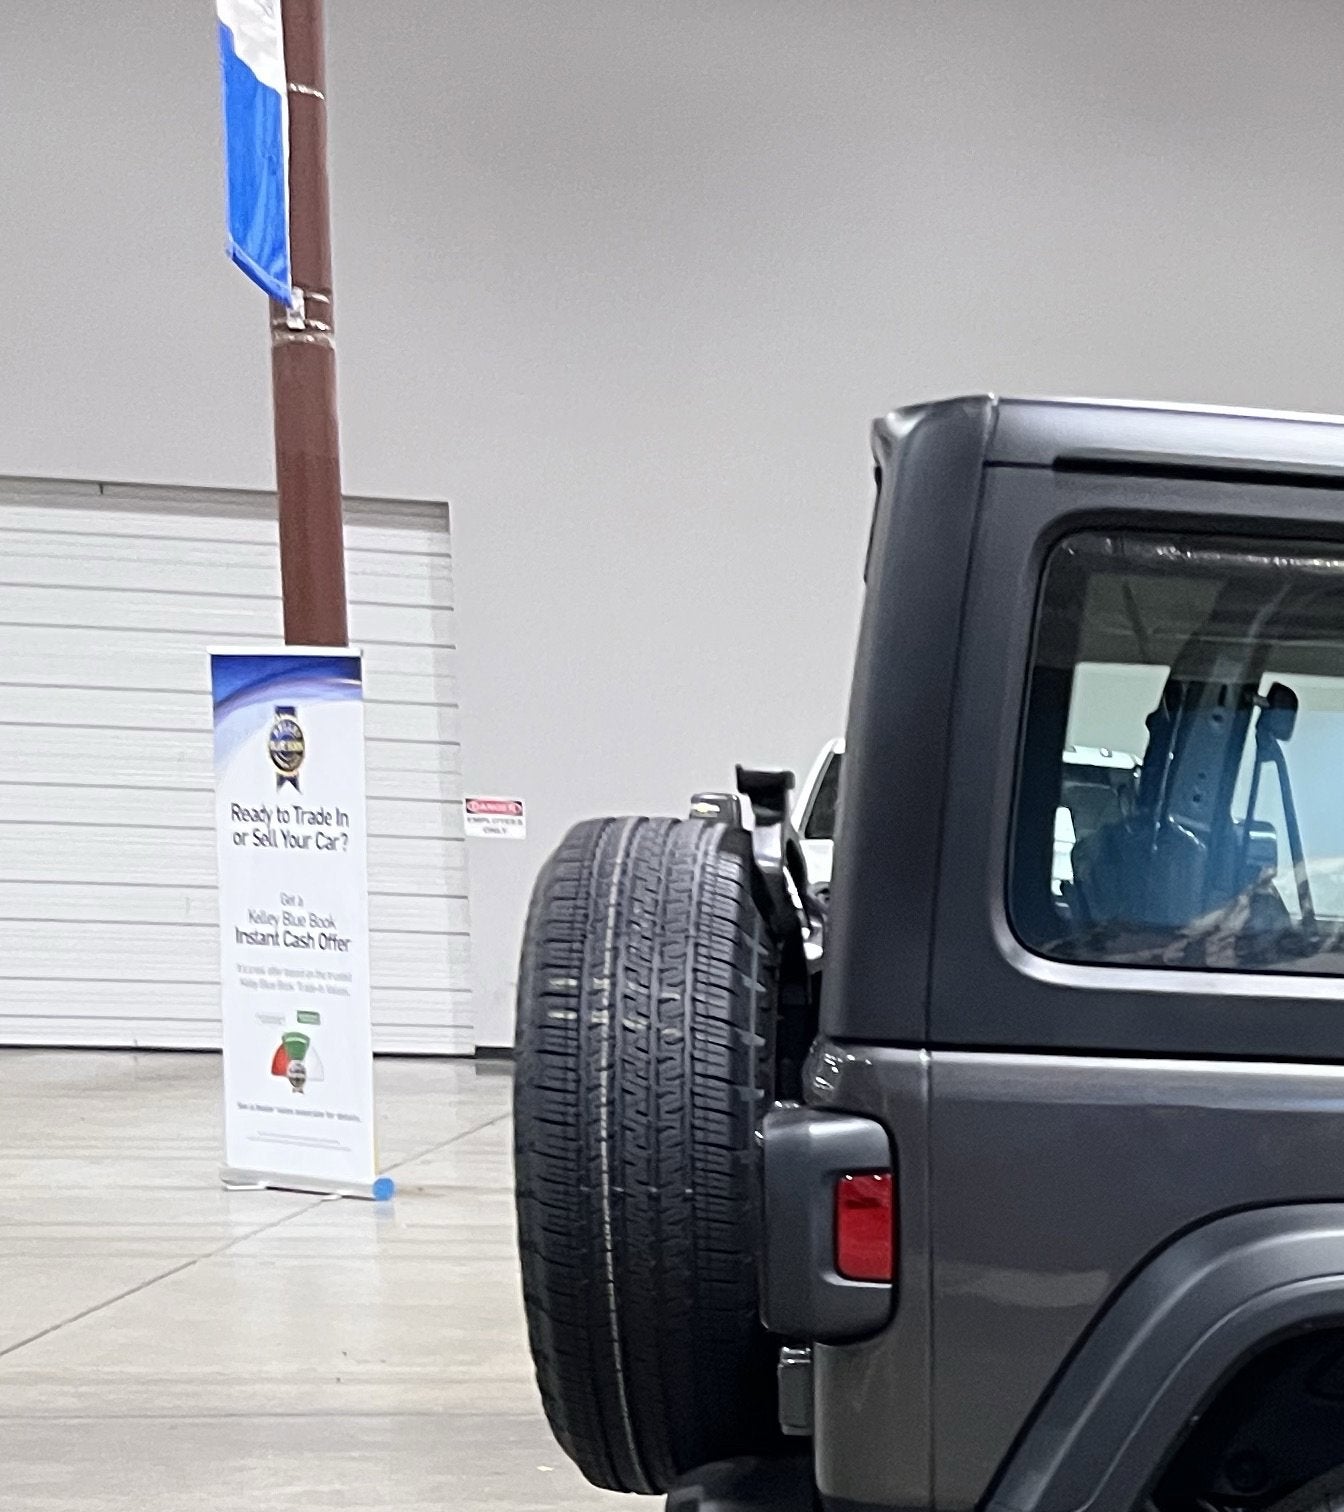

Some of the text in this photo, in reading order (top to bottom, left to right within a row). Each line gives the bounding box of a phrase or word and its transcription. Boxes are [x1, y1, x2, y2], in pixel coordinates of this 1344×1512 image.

[231, 802, 349, 828] Ready to Trade In
[232, 828, 349, 852] or Sell Your Car?
[282, 910, 307, 928] Blue
[309, 912, 337, 930] Book
[235, 926, 352, 953] Instant Cash Offer
